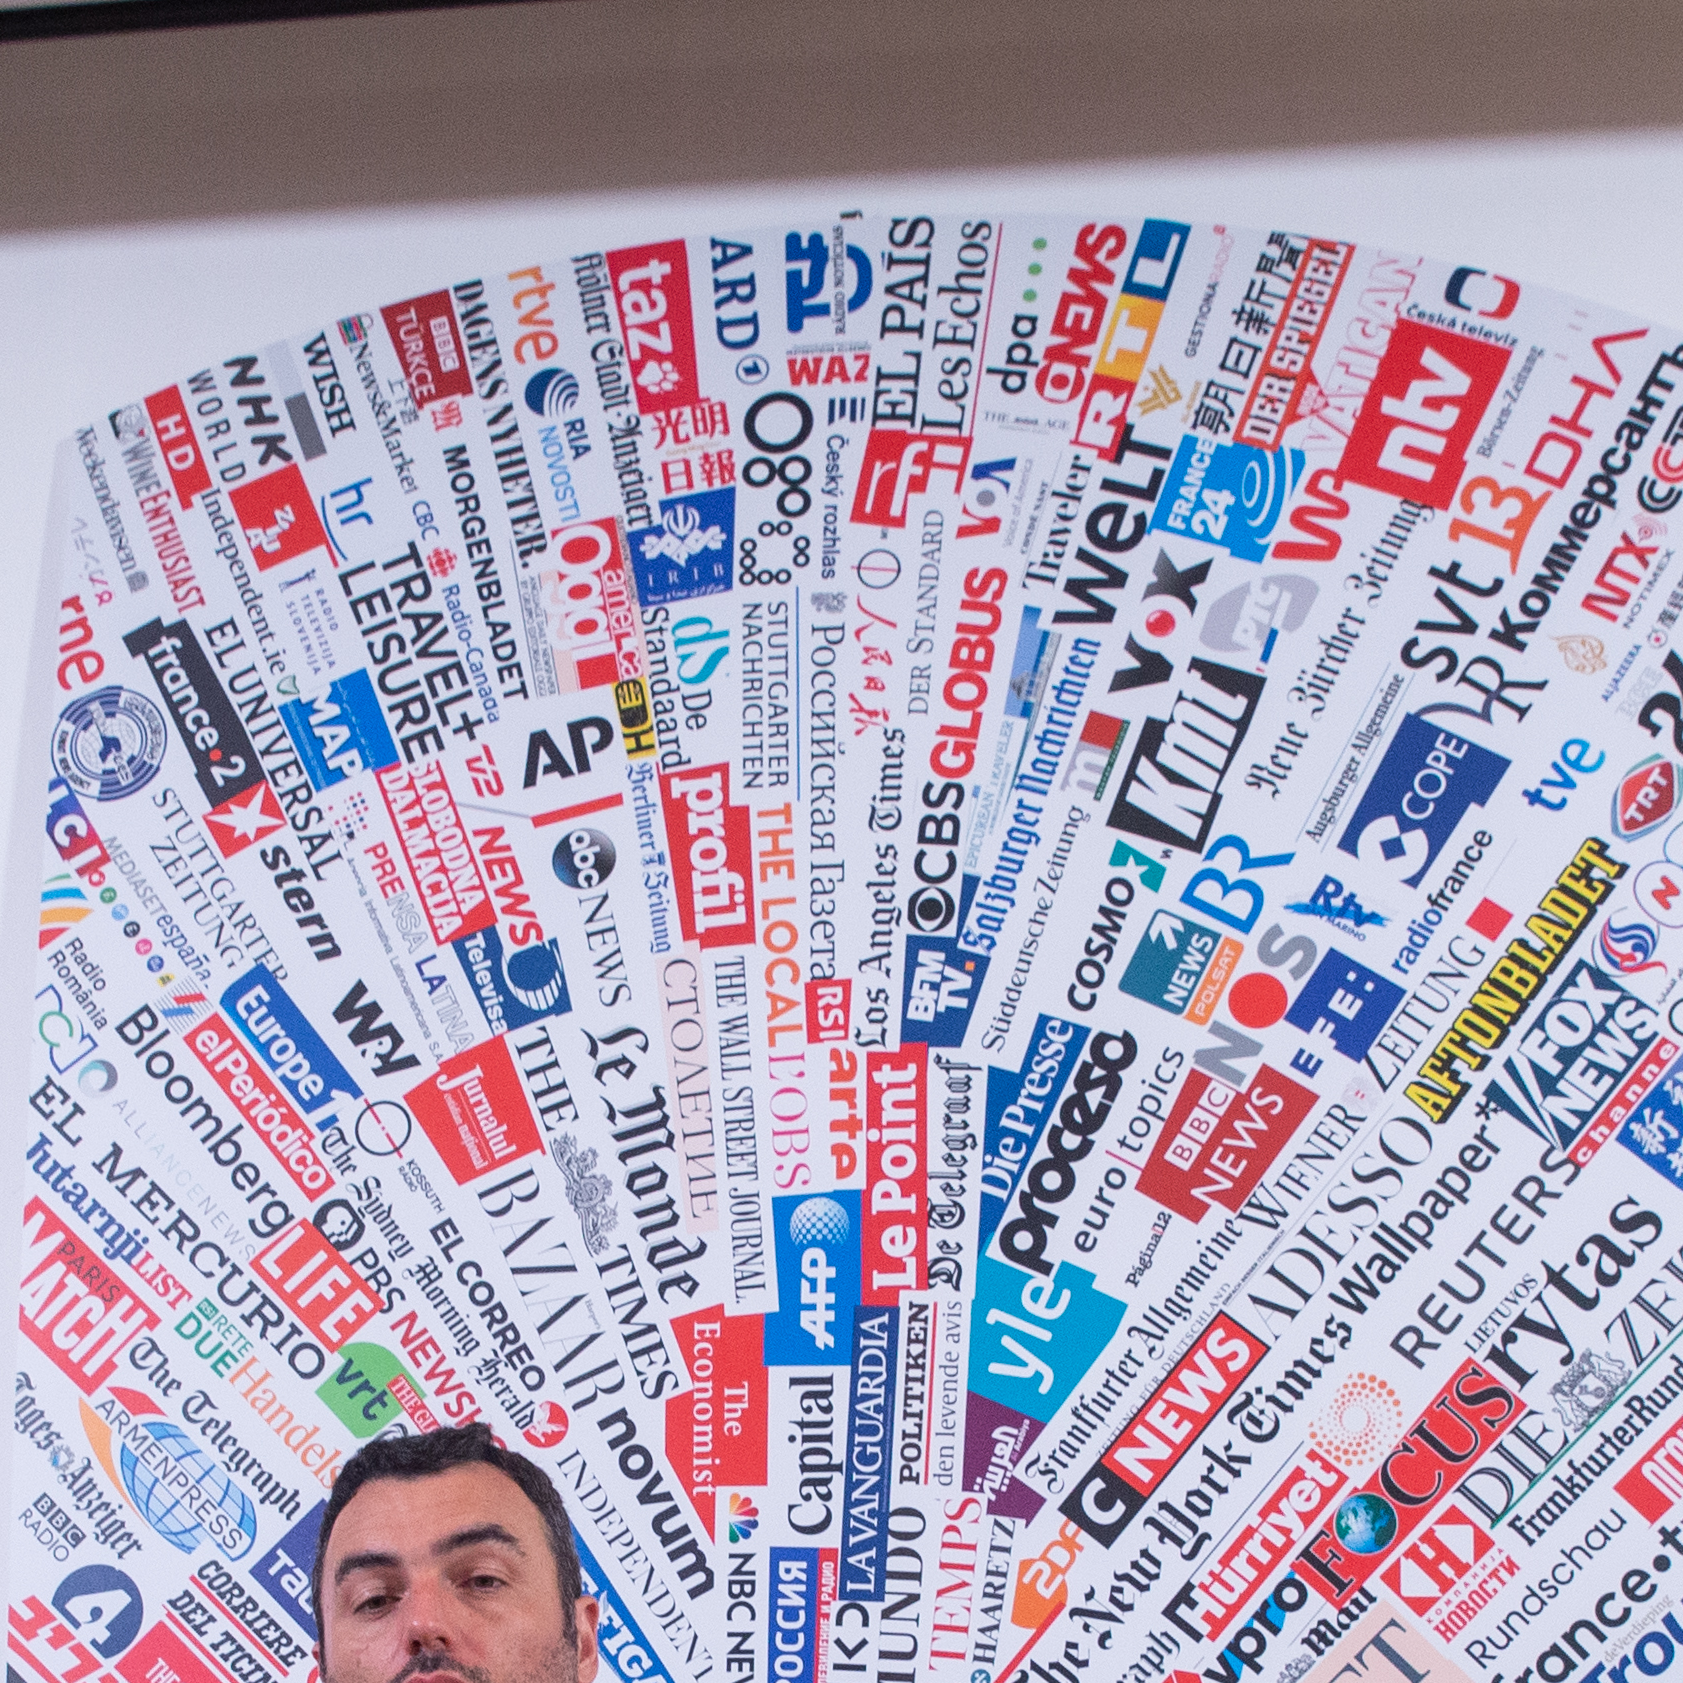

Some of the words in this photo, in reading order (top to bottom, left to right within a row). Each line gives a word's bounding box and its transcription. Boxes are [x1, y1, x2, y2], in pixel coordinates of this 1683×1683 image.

[618, 259, 673, 365] taz
[711, 238, 759, 350] ARD
[880, 215, 935, 339] PAÍS
[938, 221, 991, 350] Echos
[787, 354, 870, 387] WAZ
[871, 351, 923, 427] EL
[921, 359, 969, 436] Les
[987, 314, 1038, 393] dpa
[187, 370, 246, 485] WORLD
[224, 356, 294, 470] NHK
[1167, 439, 1215, 529] FRANCE
[1192, 489, 1235, 538] 24
[443, 445, 529, 699] MORGENBLADET
[742, 604, 763, 789] NACHRICHTEN
[767, 602, 789, 788] STUTTGARTER
[930, 567, 1009, 779] GLOBUS
[523, 716, 614, 789] AP
[869, 727, 905, 834] Times
[1403, 733, 1468, 821] COPE
[672, 772, 746, 933] profil
[757, 803, 795, 882] THE
[914, 780, 964, 884] CBS
[260, 845, 342, 961] stern
[859, 843, 903, 977] Angeles
[715, 956, 746, 1001] THE
[760, 897, 804, 1047] LOCAL
[1403, 837, 1629, 1124] AFTONBLADET
[1518, 969, 1620, 1064] FOX
[718, 1006, 751, 1079] WALL
[1539, 998, 1658, 1133] NEWS
[115, 1003, 295, 1239] Bloomberg
[722, 1084, 757, 1180] STREET
[868, 1063, 917, 1215] Point
[1074, 1167, 1127, 1252] euro
[1119, 1048, 1183, 1153] topics
[1164, 1083, 1237, 1170] BBC
[1191, 1087, 1284, 1208] NEWS
[30, 1075, 86, 1147] EL
[92, 1144, 325, 1380] MERCURIO
[260, 1225, 373, 1342] LIFE
[350, 1250, 405, 1315] PBS
[874, 1230, 916, 1291] Le
[1390, 1144, 1582, 1369] REUTERS
[429, 1217, 465, 1263] EL
[456, 1258, 546, 1392] CORREO
[693, 1321, 720, 1497] Economist
[723, 1381, 748, 1437] The
[788, 1374, 844, 1535] Capital
[849, 1313, 888, 1549] VANGUARDIA
[1112, 1327, 1250, 1485] NEWS
[33, 1492, 86, 1549] BBC
[95, 1398, 242, 1551] ARMENPRESS
[597, 1407, 715, 1600] novum
[1070, 1546, 1162, 1650] New
[1144, 1443, 1253, 1562] York
[1227, 1313, 1352, 1444] Times
[18, 1509, 69, 1562] RADIO
[727, 1551, 756, 1622] NBC
[846, 1551, 873, 1594] LA
[1466, 1507, 1628, 1668] Rundschau
